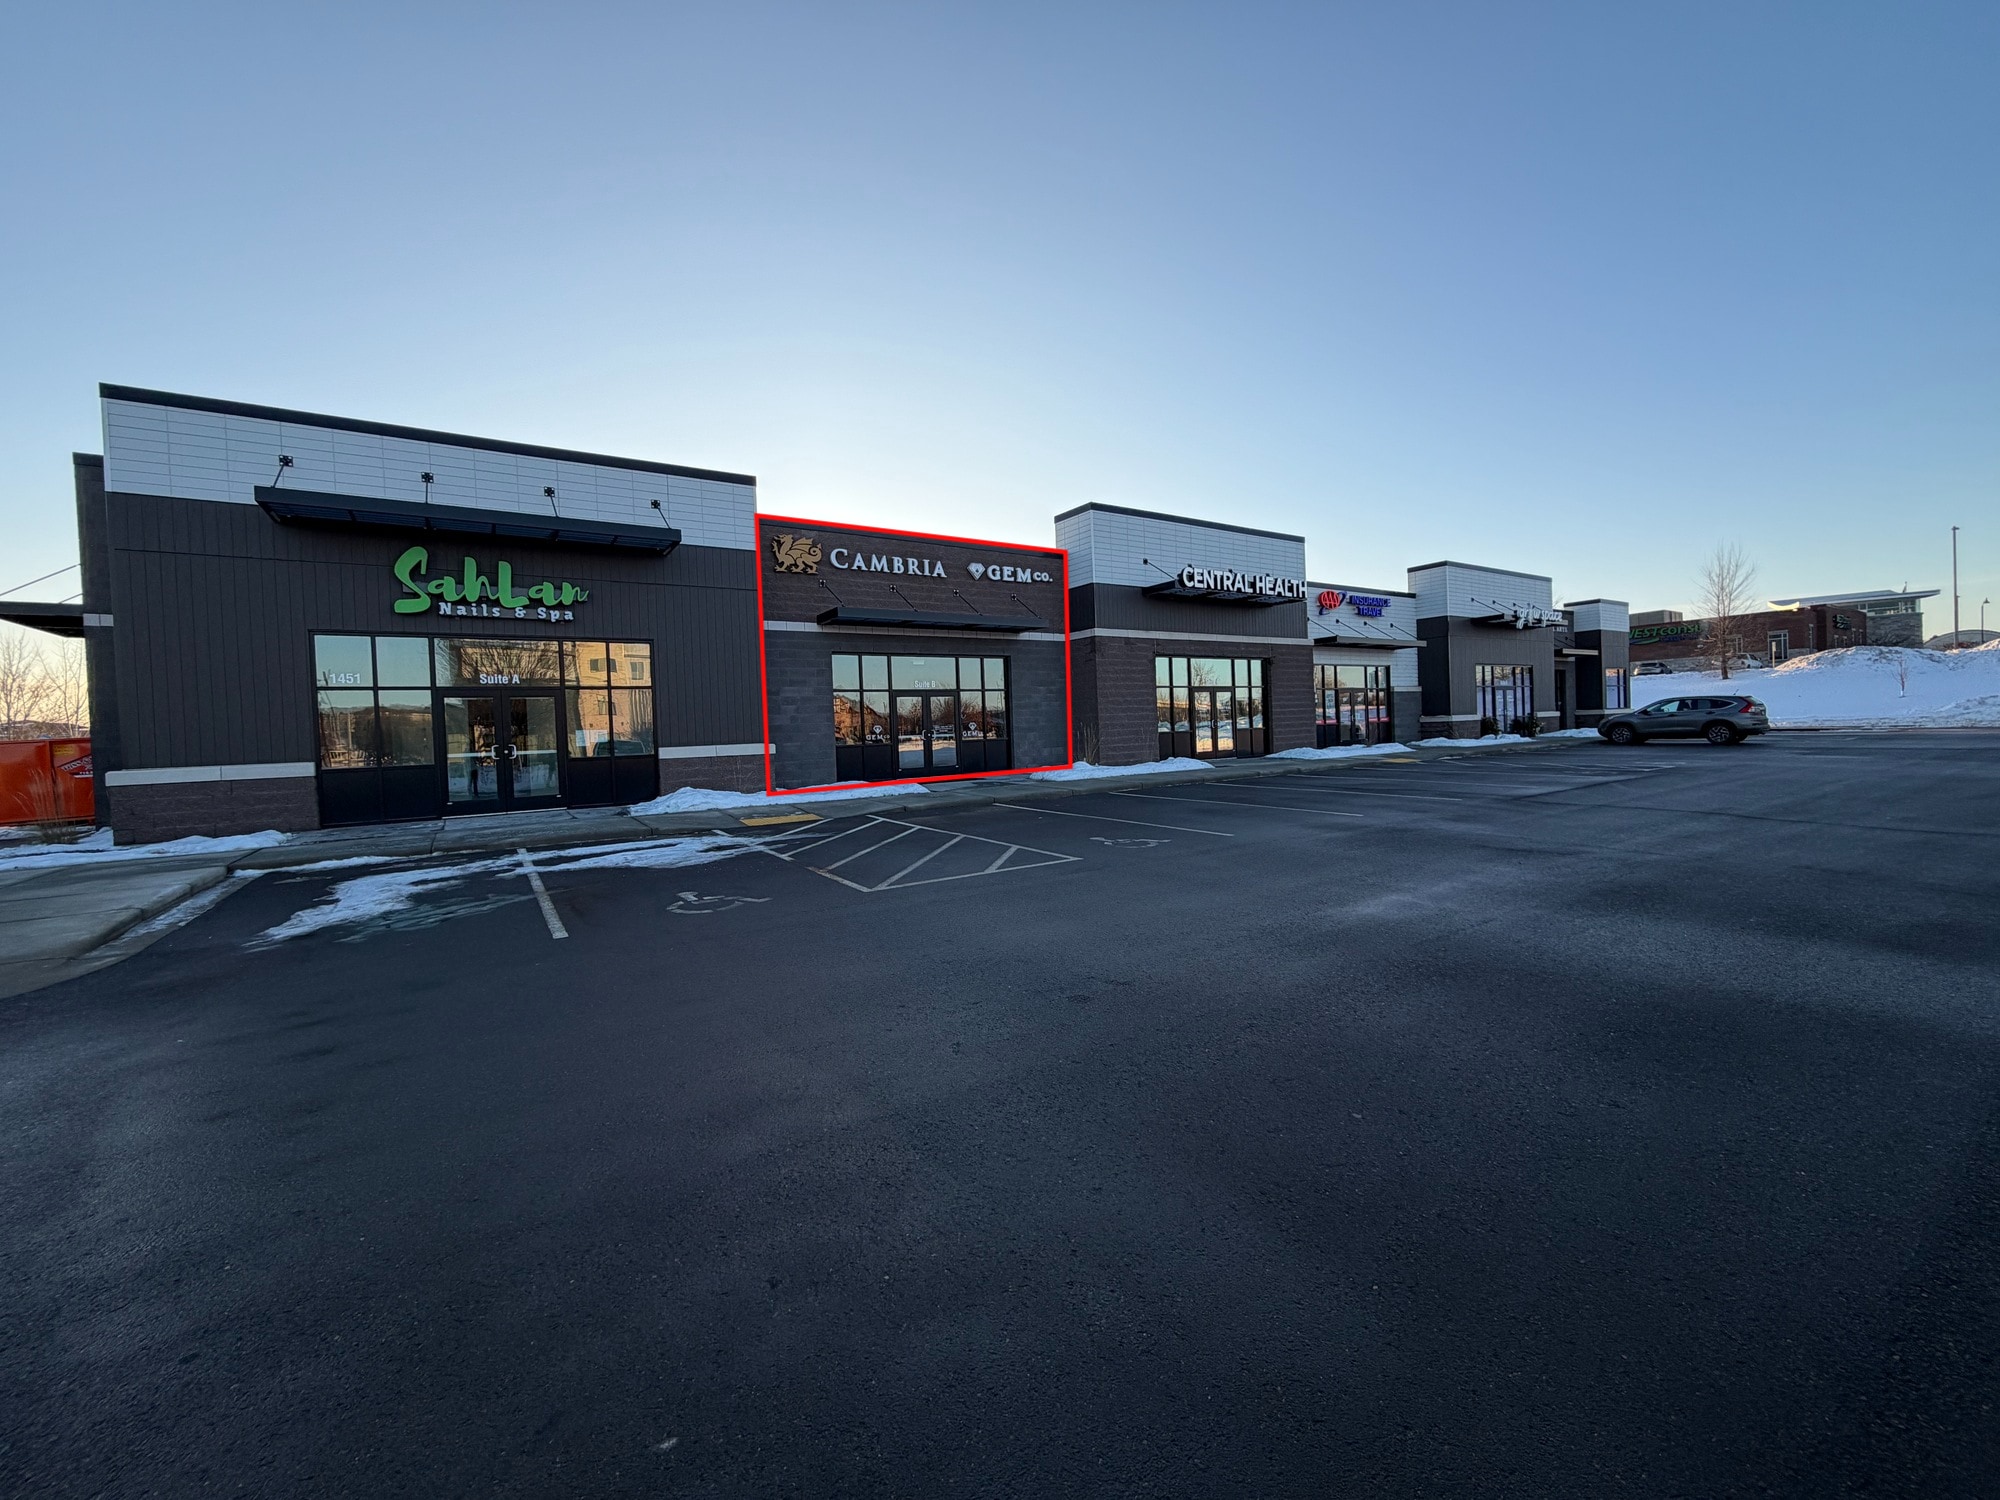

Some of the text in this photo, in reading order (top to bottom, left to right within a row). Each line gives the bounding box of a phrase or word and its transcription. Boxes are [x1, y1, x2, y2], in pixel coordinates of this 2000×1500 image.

[829, 547, 948, 579] CAMBRIA
[986, 564, 1032, 583] GEM
[1182, 566, 1308, 599] CENTRAL HEALTH
[1320, 591, 1340, 609] AAA
[1351, 595, 1392, 607] INSURANCE
[438, 601, 574, 623] Nails & Spa
[1359, 606, 1385, 617] TRAVEL
[329, 673, 362, 685] 1451
[479, 673, 521, 685] Suite A
[914, 680, 936, 688] Suite B
